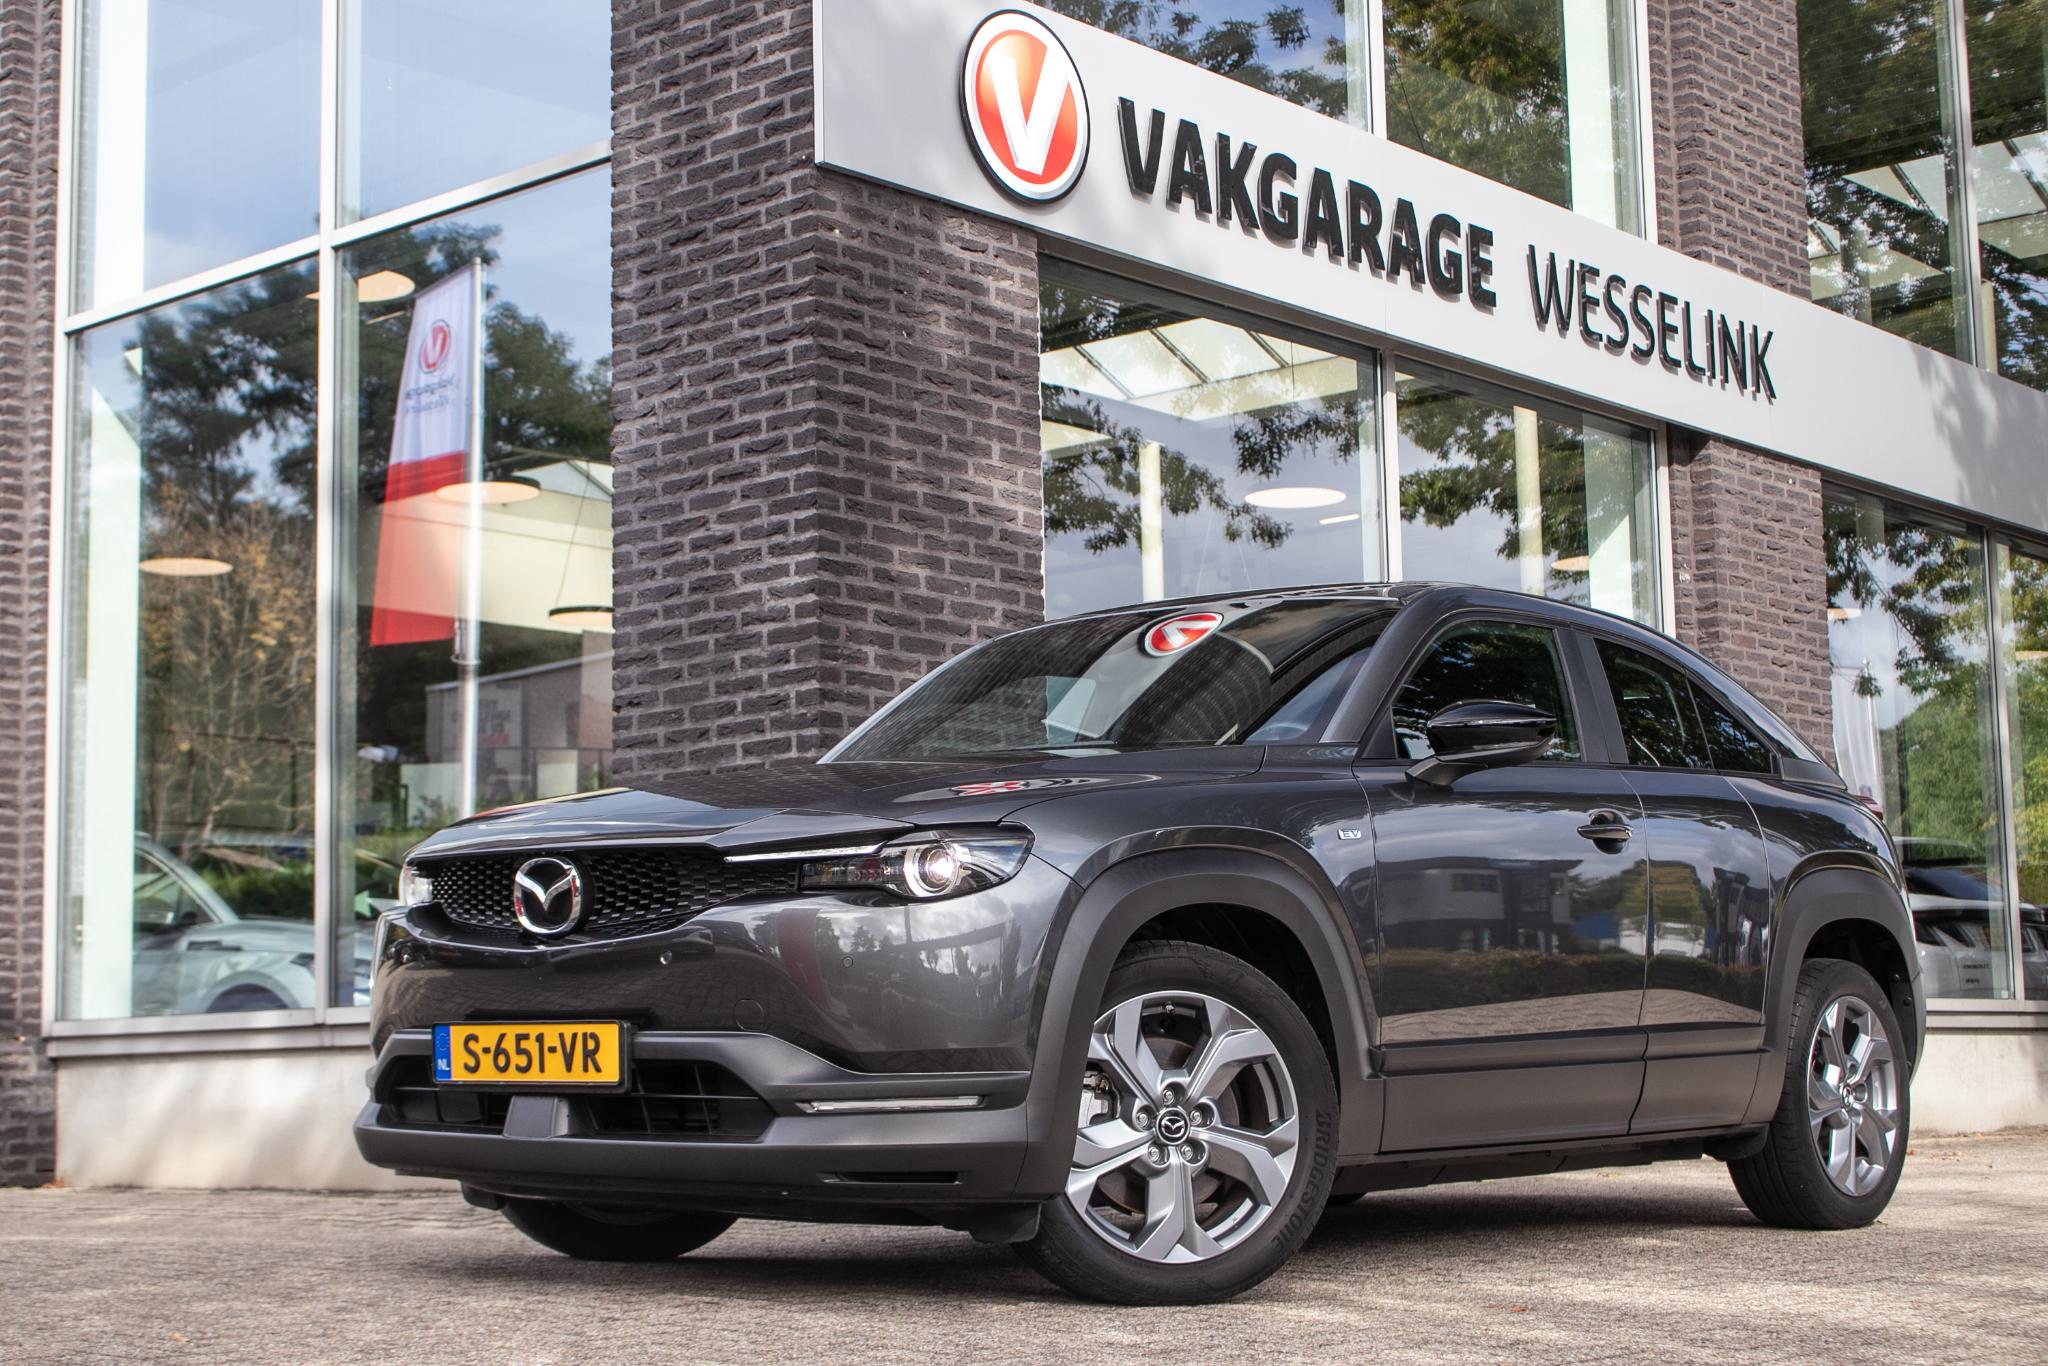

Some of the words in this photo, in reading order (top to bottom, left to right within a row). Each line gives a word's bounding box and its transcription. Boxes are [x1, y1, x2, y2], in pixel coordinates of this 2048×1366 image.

[989, 43, 1072, 176] V
[1117, 97, 1497, 308] VAKGARAGE
[1527, 244, 1777, 402] WESSELINK
[438, 1058, 450, 1071] NL
[463, 1031, 602, 1074] S-651-VR
